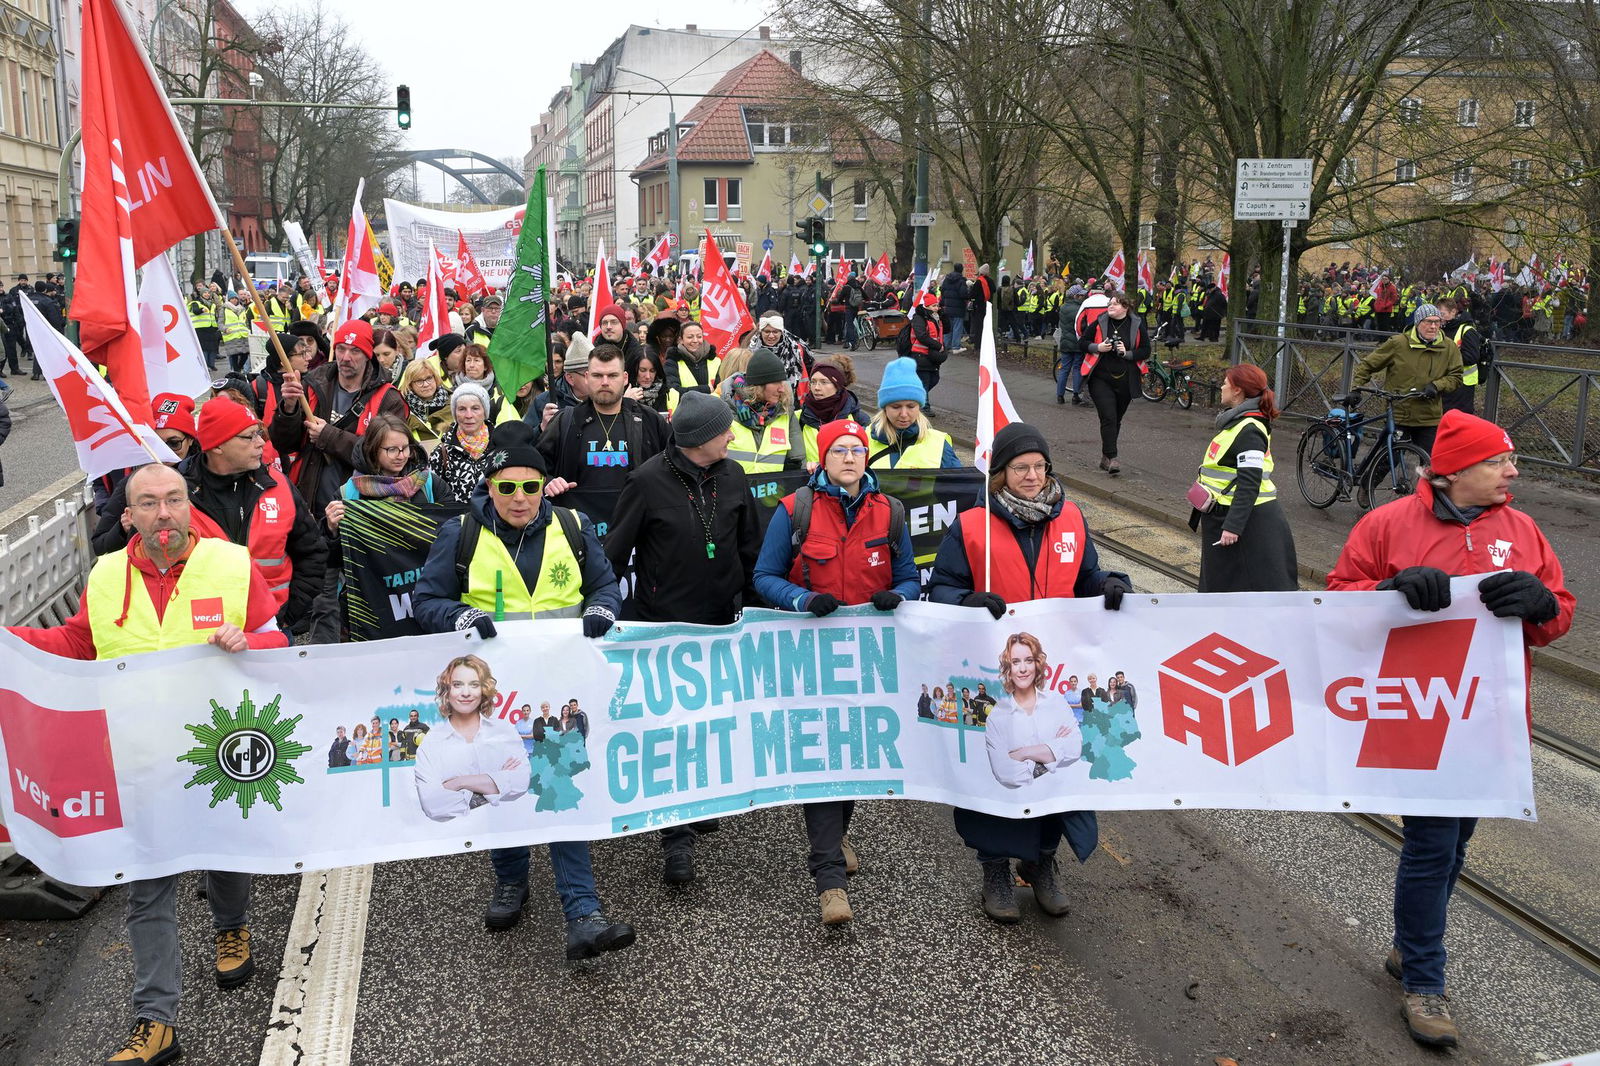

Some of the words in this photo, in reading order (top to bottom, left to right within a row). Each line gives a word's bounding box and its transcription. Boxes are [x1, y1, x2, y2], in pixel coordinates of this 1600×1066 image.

[259, 502, 280, 512] GEW
[910, 499, 958, 537] EN
[1053, 541, 1078, 553] GEW
[194, 613, 222, 622] ver.di
[601, 626, 899, 721] ZUSAMMEN
[1324, 676, 1480, 721] GEW
[606, 716, 738, 804] GEHT
[750, 706, 904, 777] MEHR
[15, 767, 105, 818] ver.di
